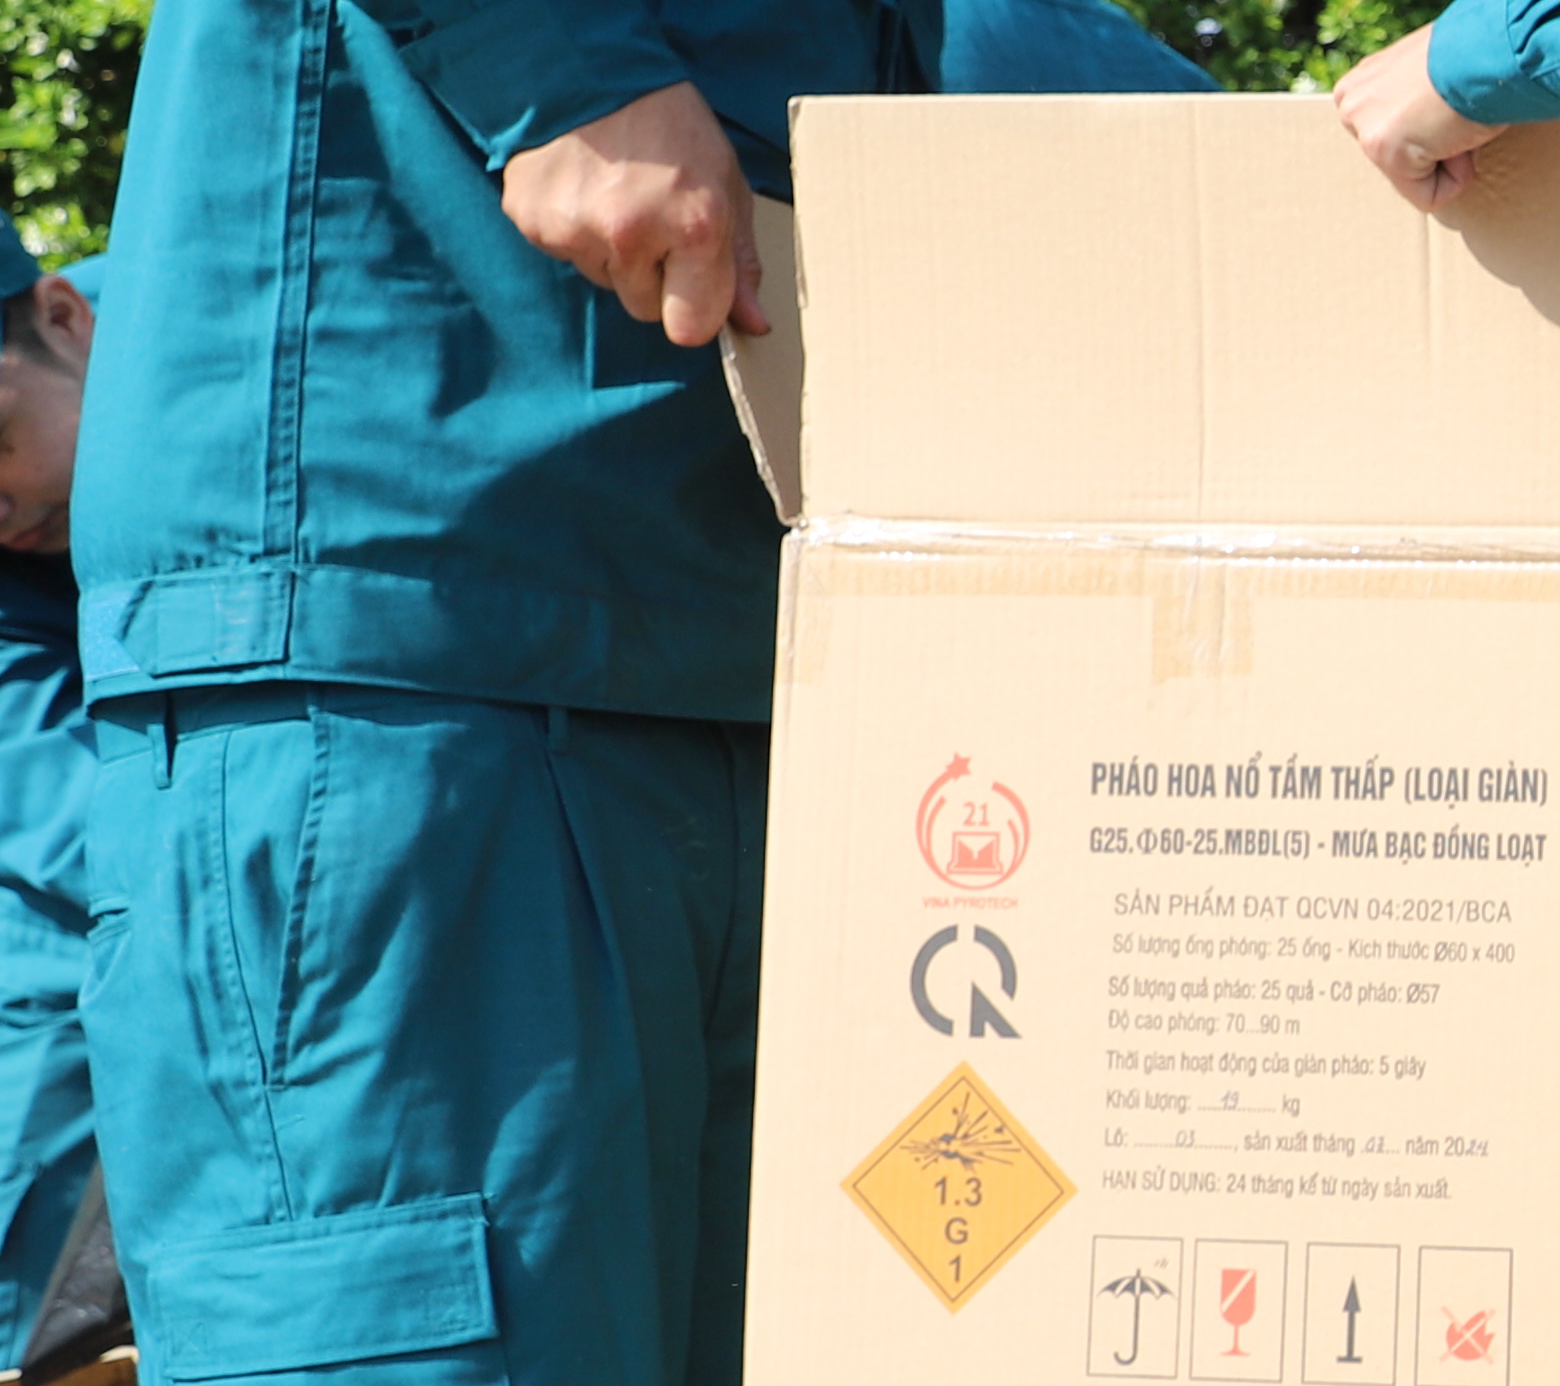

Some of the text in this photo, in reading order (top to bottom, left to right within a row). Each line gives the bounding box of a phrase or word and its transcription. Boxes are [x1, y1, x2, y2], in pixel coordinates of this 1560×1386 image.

[1090, 755, 1160, 797] PHÁO
[1166, 762, 1218, 798] HOA
[1329, 756, 1396, 801] THẤP
[1403, 766, 1470, 809] (LOẠI
[963, 801, 991, 827] 21
[933, 1176, 983, 1208] 1.3
[944, 1216, 970, 1245] G
[948, 1255, 963, 1284] 1
